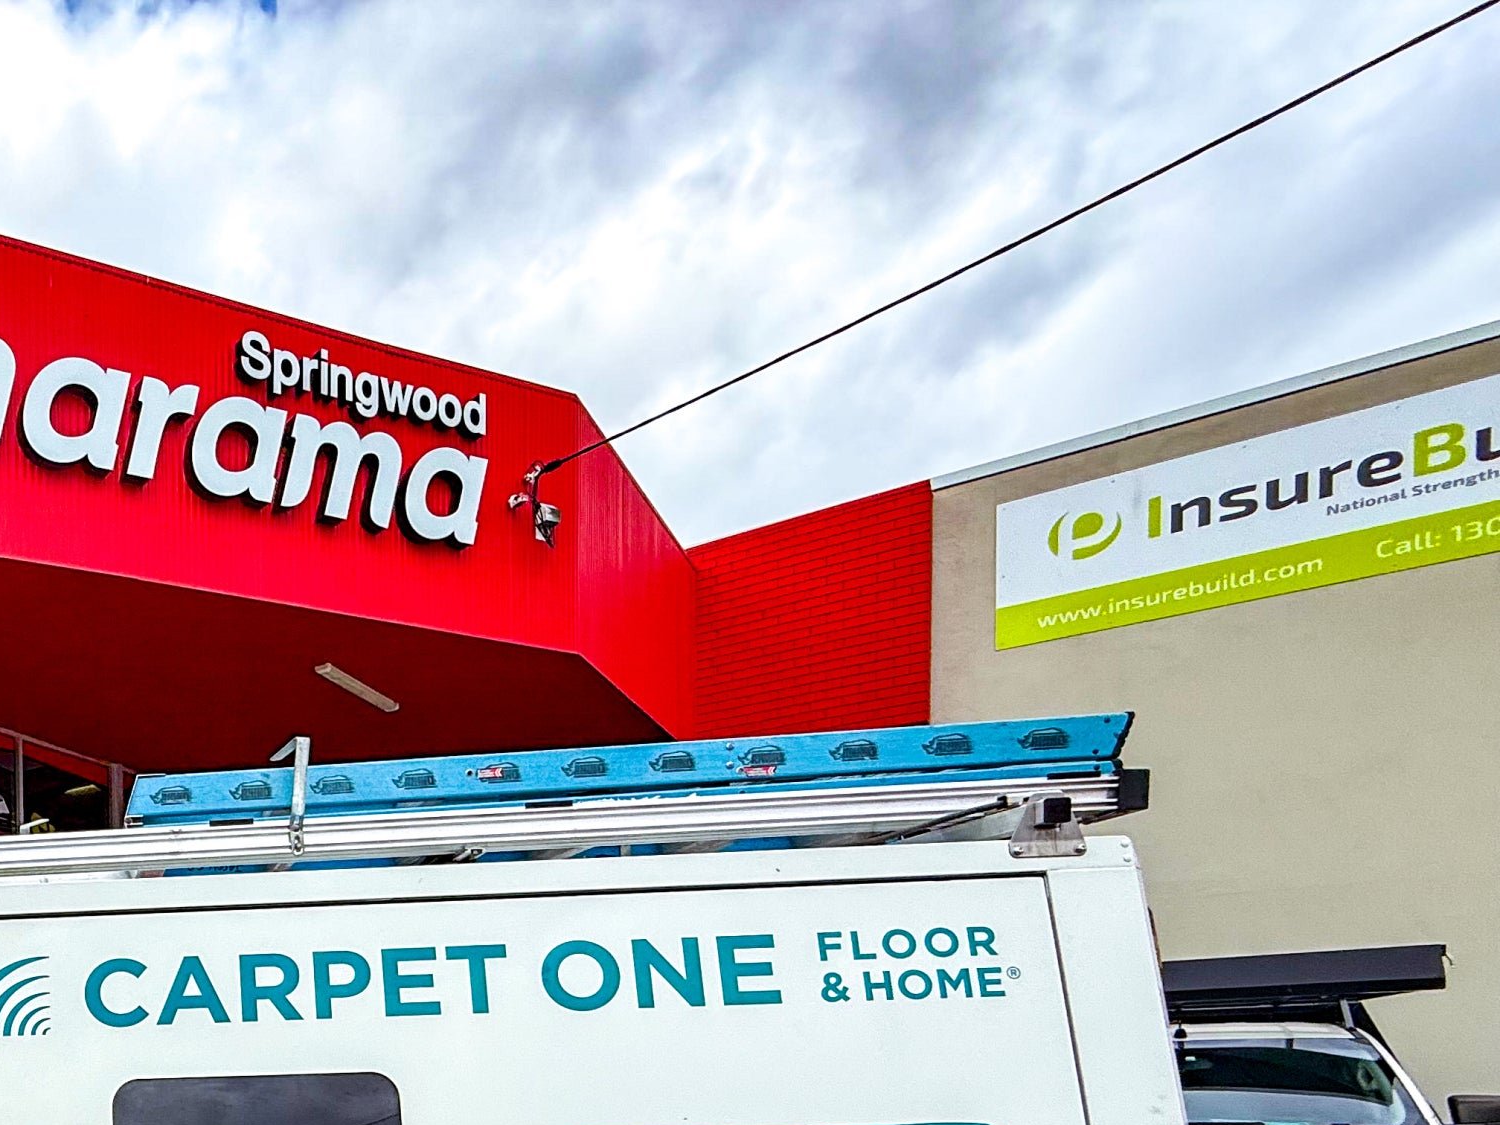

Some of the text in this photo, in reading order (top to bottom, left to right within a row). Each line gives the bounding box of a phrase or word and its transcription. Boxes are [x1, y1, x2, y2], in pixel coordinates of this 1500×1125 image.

[240, 331, 487, 437] Springwood
[1326, 488, 1408, 516] National
[1376, 531, 1441, 559] Call:
[1037, 557, 1323, 629] www.insurebuild.com
[817, 926, 998, 962] FLOOR
[83, 933, 783, 1029] CARPET ONE
[821, 972, 851, 1003] &
